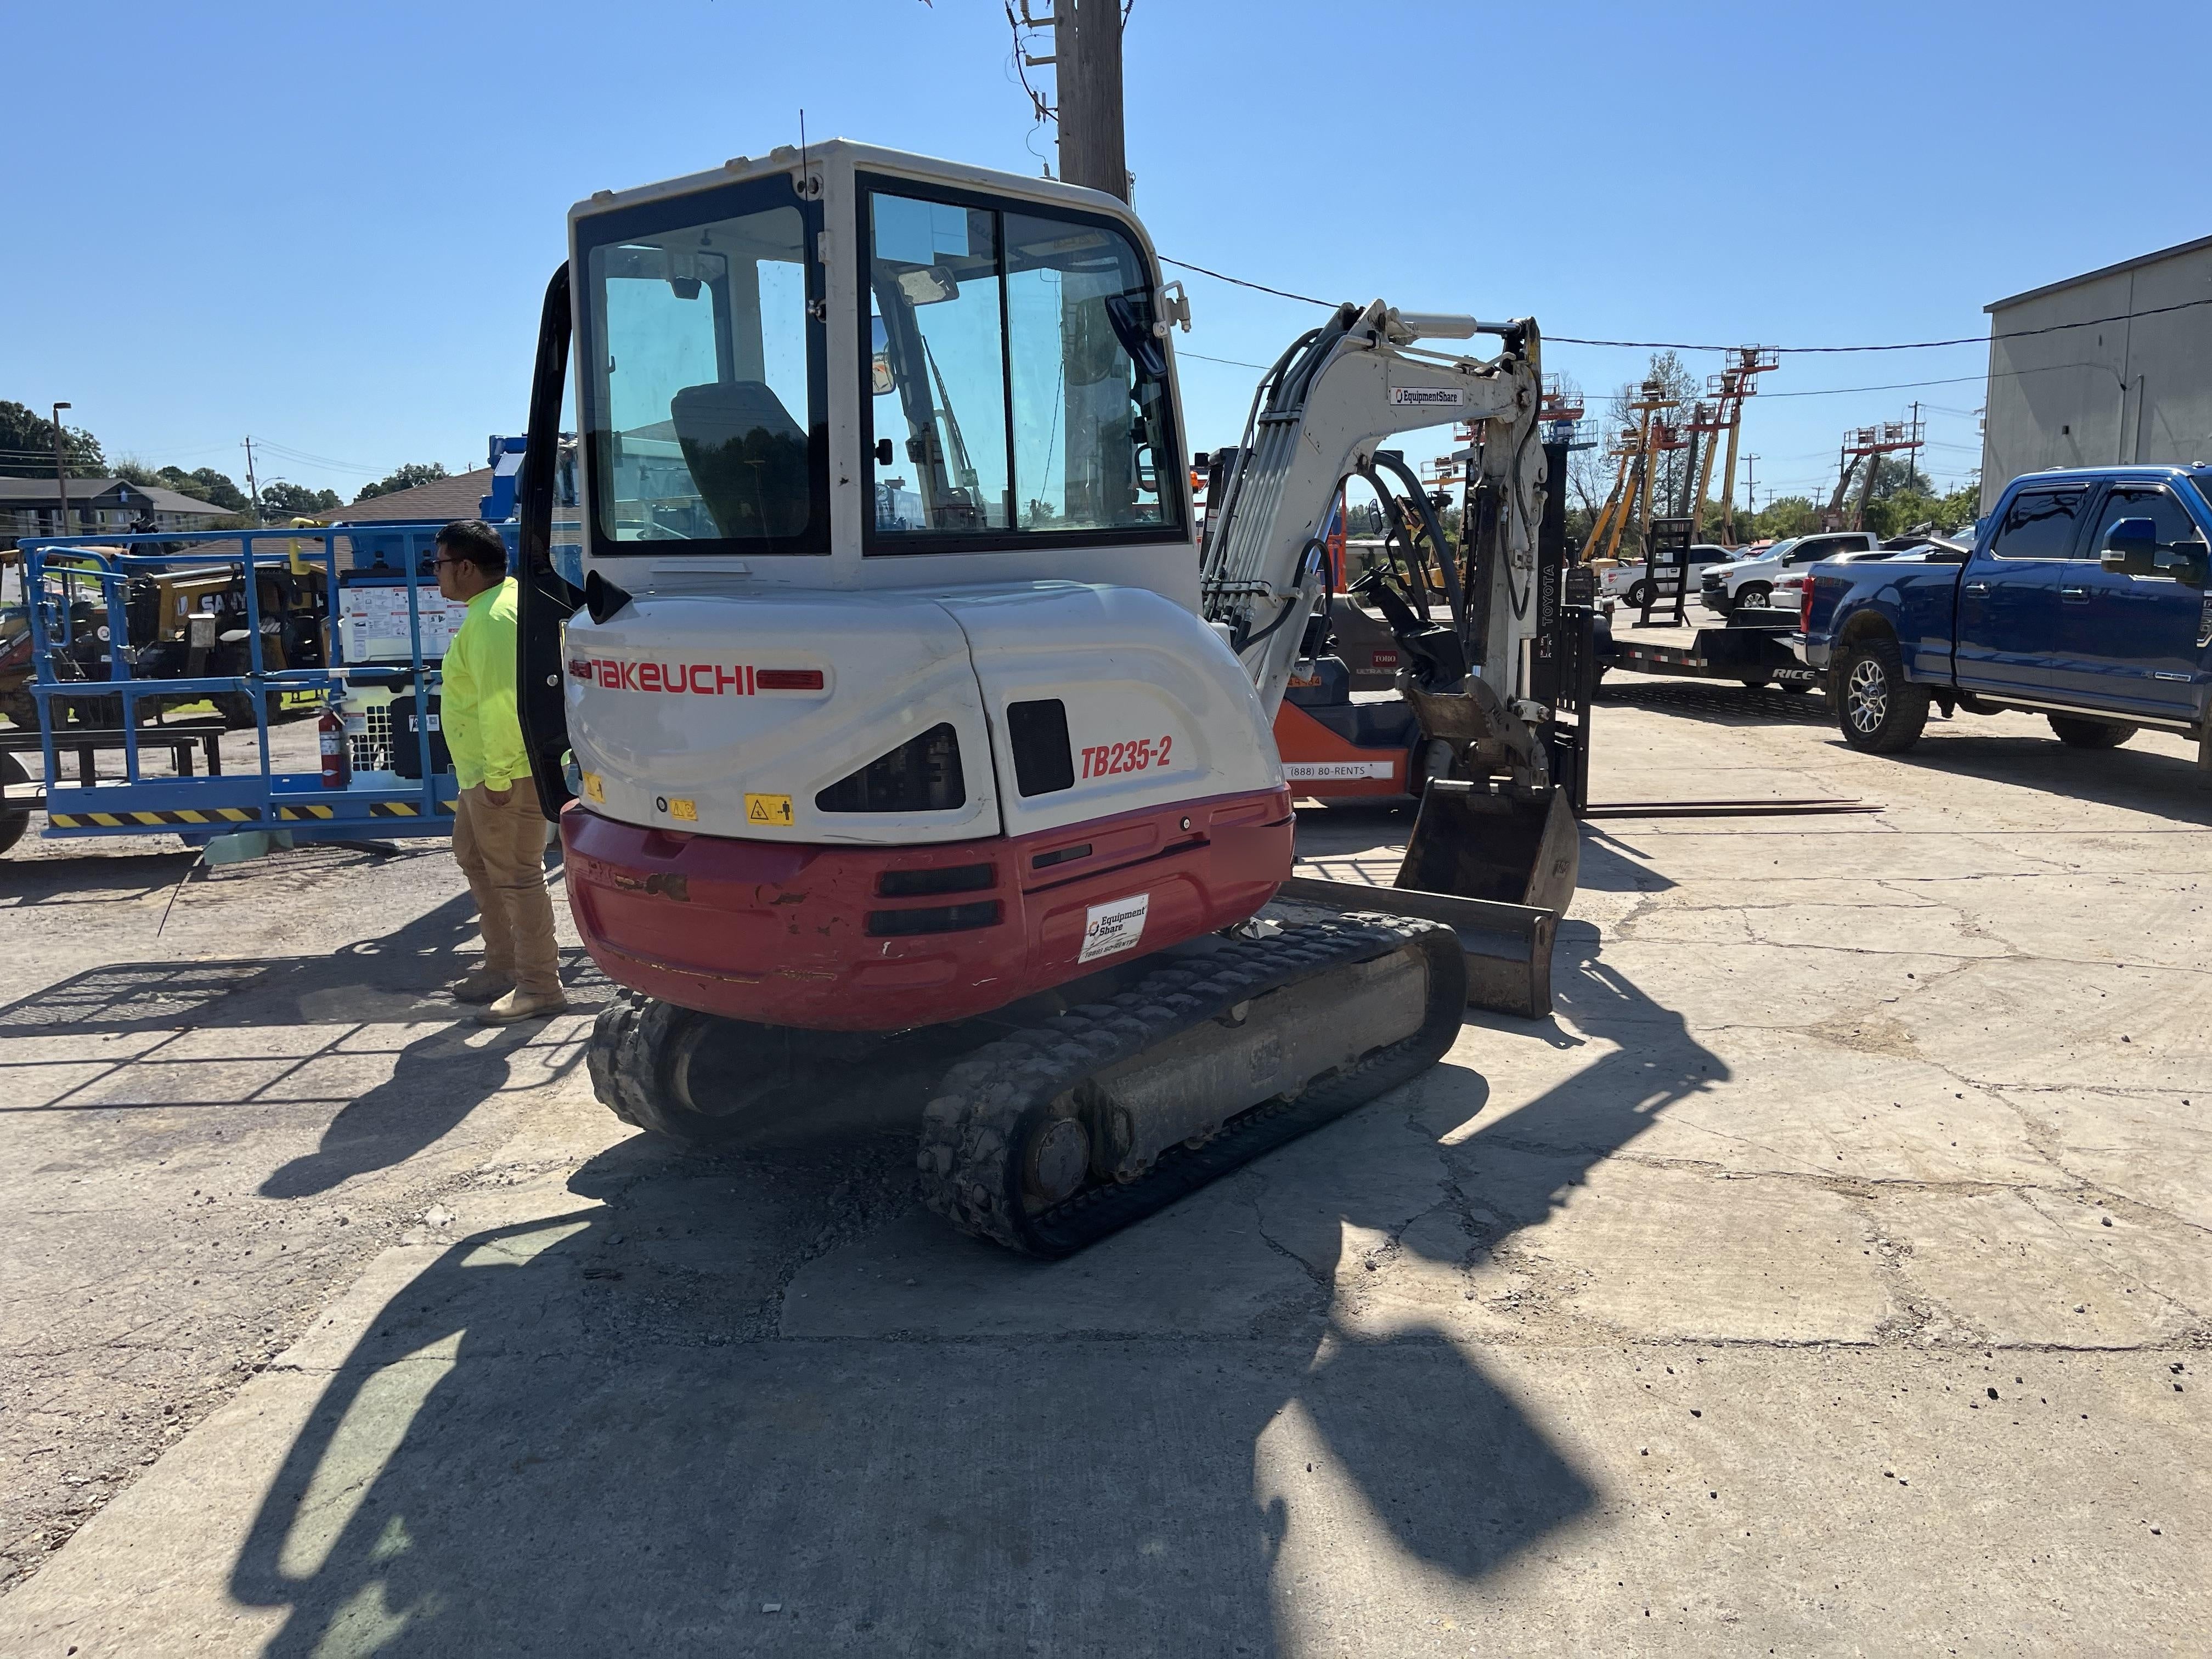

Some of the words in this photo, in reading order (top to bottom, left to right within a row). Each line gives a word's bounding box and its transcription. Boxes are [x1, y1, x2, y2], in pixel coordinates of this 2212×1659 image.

[1403, 390, 1458, 404] EquipmentShare
[1542, 564, 1554, 627] TOYOTA
[1772, 668, 1815, 680] RICE
[1081, 736, 1172, 779] TB235-2
[1291, 768, 1314, 777] (888)
[1318, 767, 1364, 775] 80-RENTS
[1101, 906, 1145, 926] Equipment
[1099, 924, 1123, 936] Share
